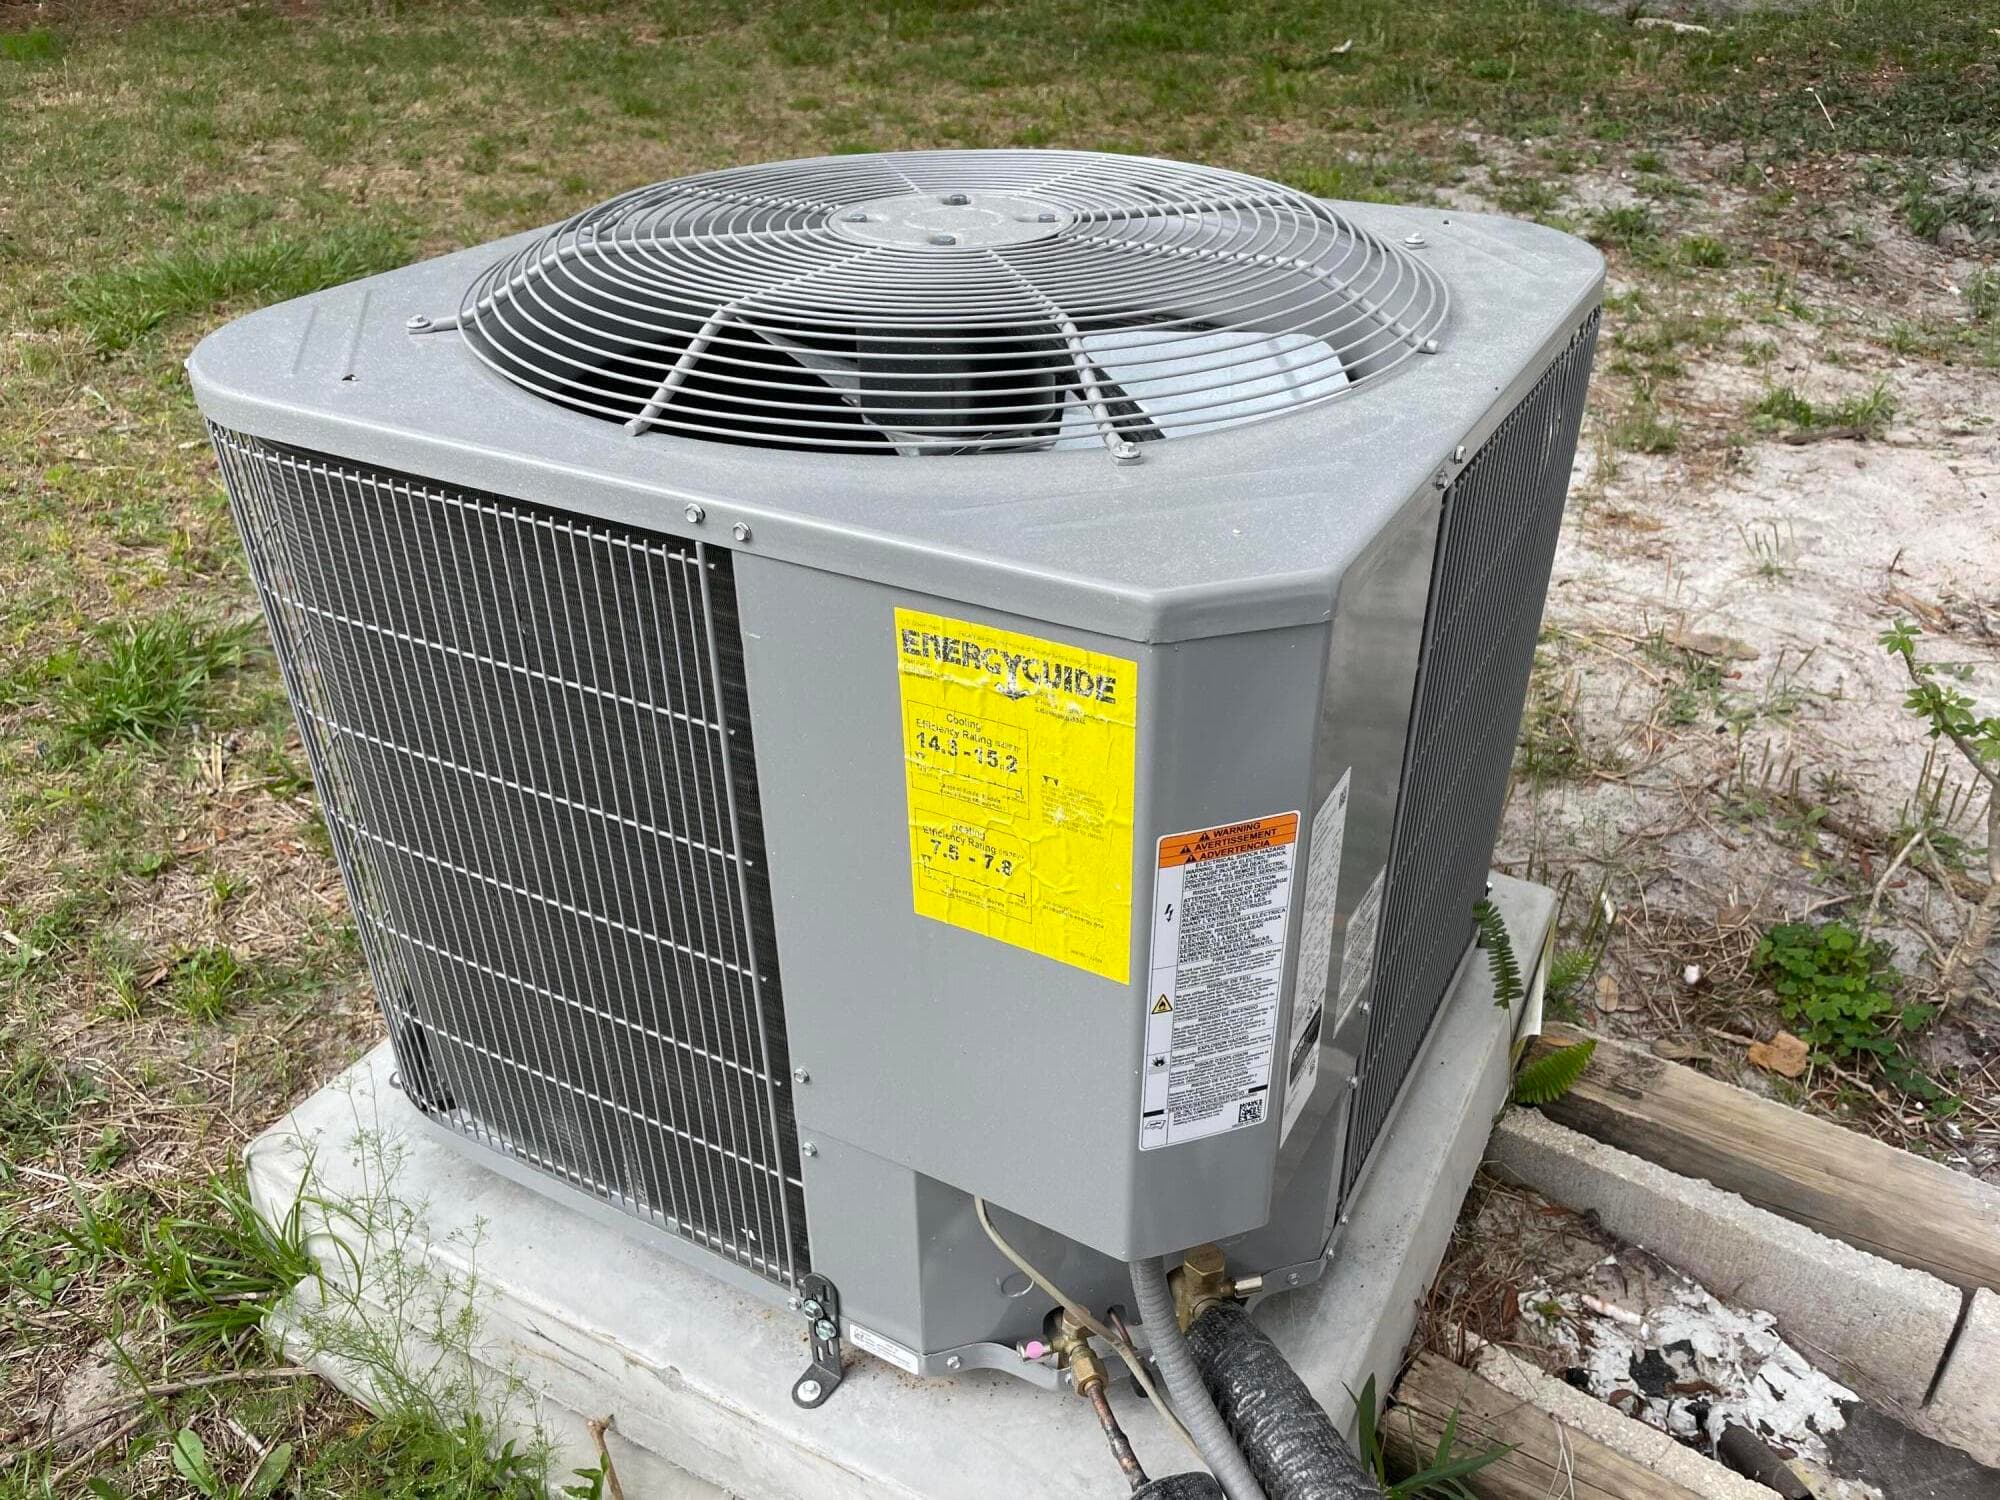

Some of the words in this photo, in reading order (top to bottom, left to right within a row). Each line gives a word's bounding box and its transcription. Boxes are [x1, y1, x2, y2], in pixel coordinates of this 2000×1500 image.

[946, 712, 981, 733] Cooling
[915, 717, 959, 738] Efficiency
[962, 729, 992, 747] Rating
[1213, 822, 1260, 837] WARNING
[922, 823, 965, 846] Efficiency
[967, 837, 996, 855] Rating
[1194, 828, 1277, 851] AVERTISSEMENT
[1195, 855, 1234, 867] ELECTRICAL
[1236, 851, 1256, 859] SHOCK
[1259, 845, 1285, 855] HAZARD
[1199, 839, 1270, 860] ADVERTENCIA
[1238, 854, 1265, 864] ELECTRIC
[1266, 850, 1286, 859] SHOCK
[1184, 874, 1219, 885] DISCONNECT
[1233, 866, 1257, 875] REMOTE
[1198, 869, 1216, 877] CAUSE
[1219, 865, 1238, 873] INJURY
[1184, 881, 1205, 890] POWER
[1206, 875, 1234, 886] SUPPLIES
[1234, 871, 1256, 880] BEFORE
[1192, 886, 1216, 895] RISQUE
[1220, 886, 1243, 895] RISQUE
[1223, 890, 1250, 900] POUVANT
[1196, 898, 1232, 910] BLESSURES
[1180, 924, 1205, 934] RIESGO
[1216, 915, 1250, 927] DESCARGA
[1181, 919, 1200, 928] AVANT
[1248, 915, 1281, 926] DESCARGA
[1178, 955, 1199, 963] ANTES
[1226, 950, 1251, 959] HAZARD
